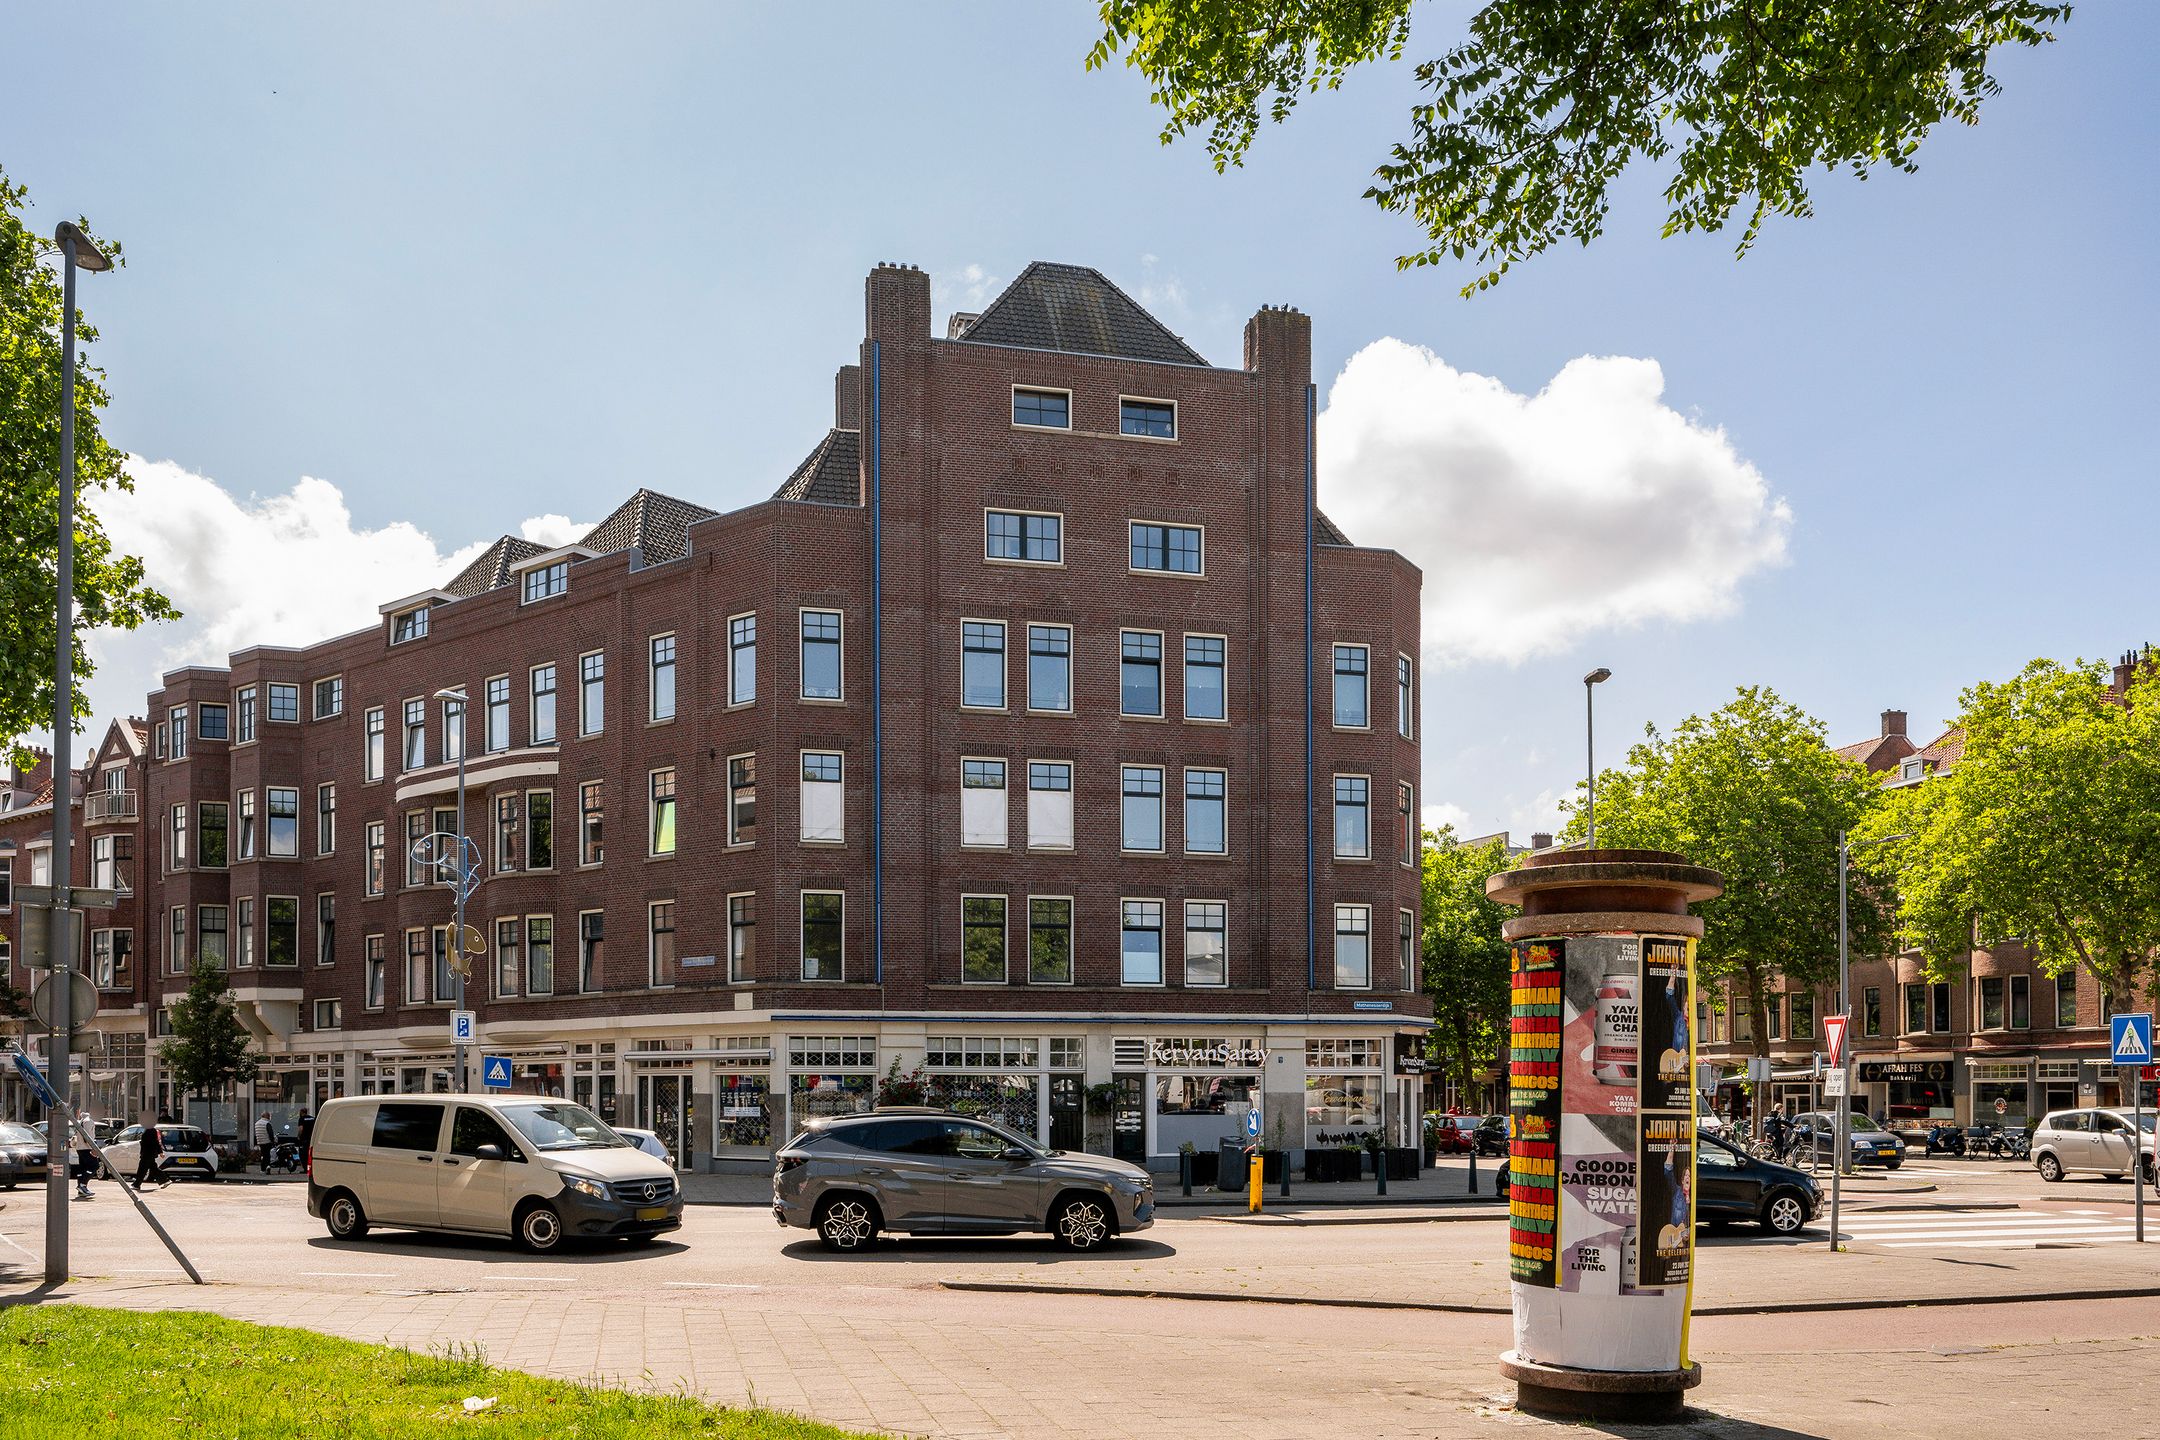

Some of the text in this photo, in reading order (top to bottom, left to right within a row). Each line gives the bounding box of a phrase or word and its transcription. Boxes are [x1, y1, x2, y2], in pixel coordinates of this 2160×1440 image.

[1647, 944, 1679, 964] JOHN
[1613, 1023, 1638, 1033] CHA
[1146, 1042, 1272, 1068] KervanSaray
[1882, 1064, 1924, 1073] AFRAH FES
[1646, 1120, 1677, 1138] JOHN
[1562, 1173, 1637, 1187] CARBON
[1587, 1187, 1637, 1201] SUGA
[1586, 1200, 1637, 1215] WATE
[1578, 1248, 1600, 1256] FOR
[1578, 1256, 1600, 1264] THE
[1571, 1263, 1606, 1272] LIVING
